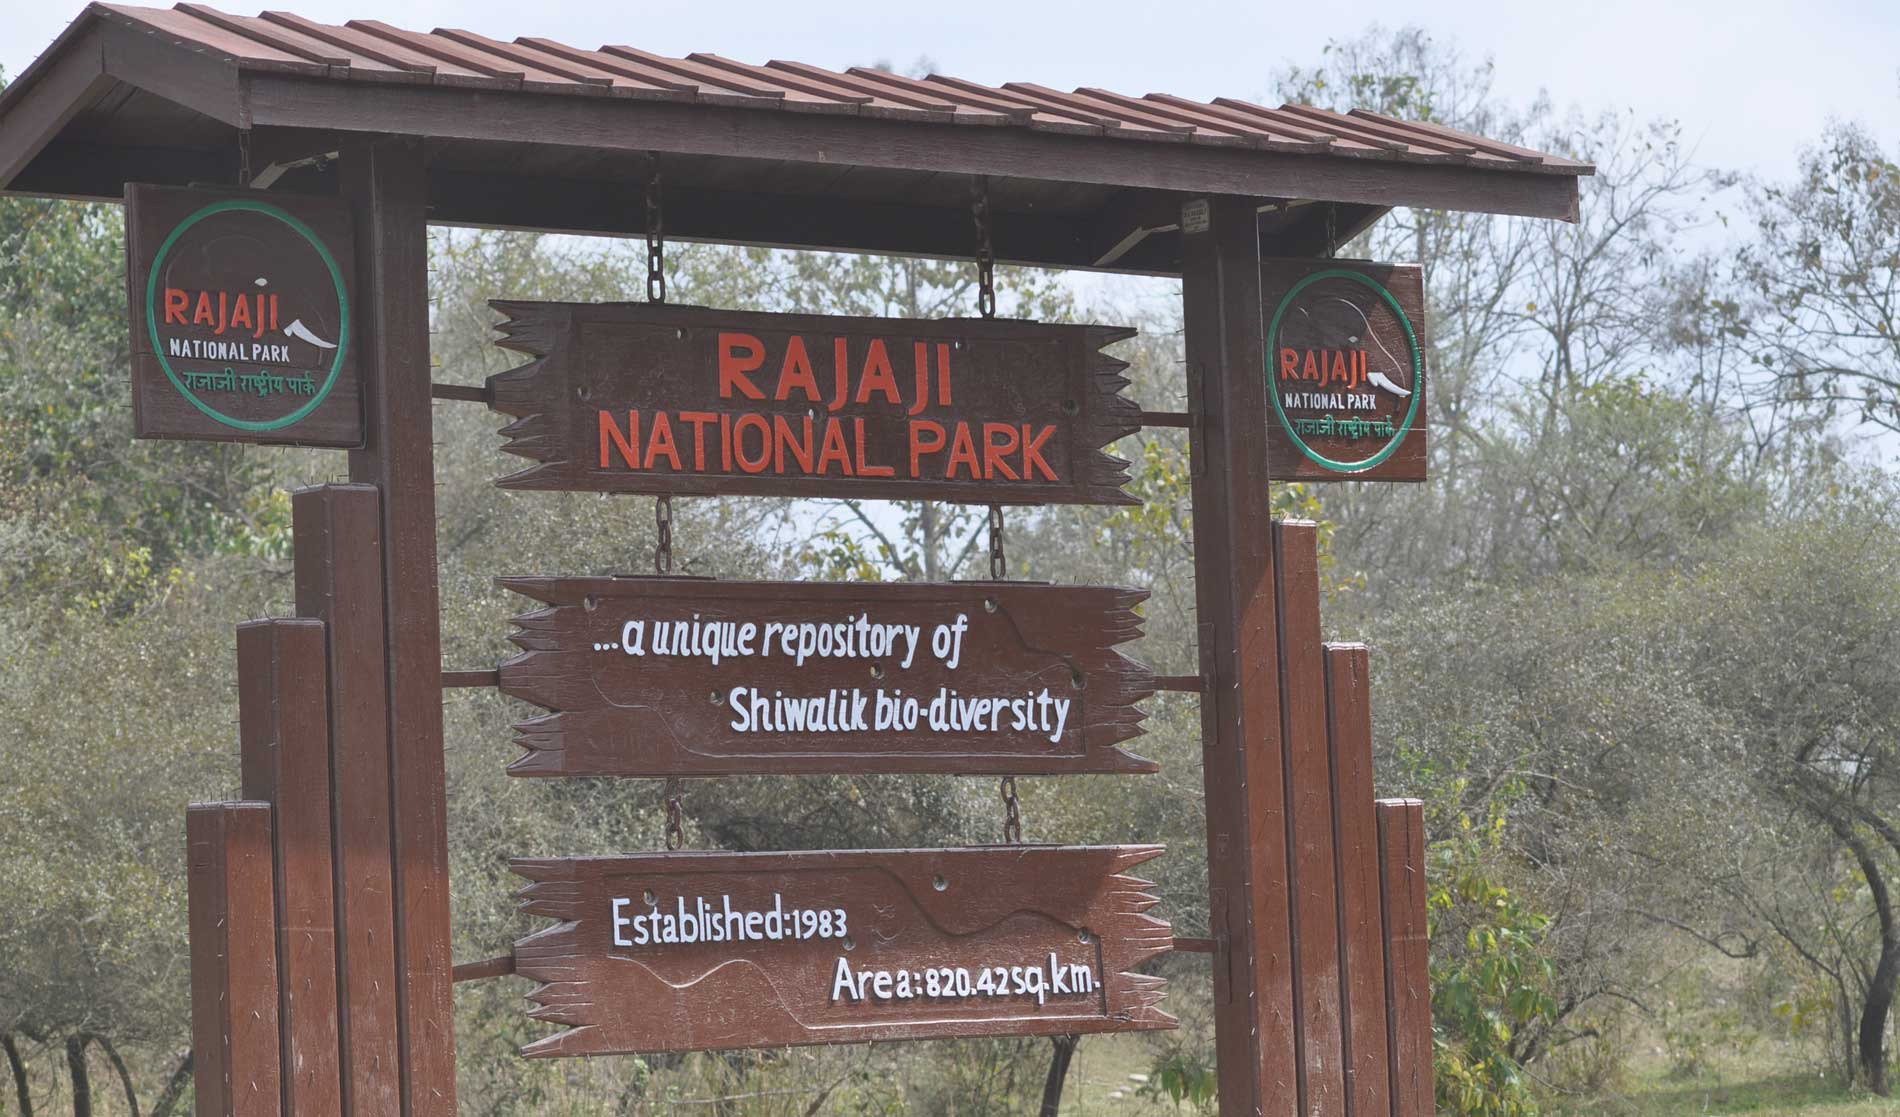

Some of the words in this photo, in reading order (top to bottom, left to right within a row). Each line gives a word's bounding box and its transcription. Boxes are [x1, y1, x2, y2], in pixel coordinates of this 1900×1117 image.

[164, 288, 278, 339] RAJAJI
[169, 338, 249, 361] NATIONAL
[252, 343, 291, 363] PARK
[1280, 349, 1367, 388] RAJAJI
[183, 367, 236, 393] राजाजी
[240, 371, 284, 396] राष्ट्रीय
[286, 371, 315, 395] पार्क
[718, 332, 952, 415] RAJAJI
[1285, 392, 1345, 410] NATIONAL
[1347, 394, 1377, 410] PARK
[598, 409, 895, 478] NATIONAL
[909, 420, 1060, 482] PARK
[1295, 414, 1336, 436] राजाजी
[1337, 416, 1371, 440] राष्ट्रीय
[1374, 415, 1396, 437] पार्क
[650, 612, 755, 667] unique
[761, 612, 920, 668] repository
[932, 613, 968, 669] of
[729, 686, 869, 734] Shiwalik
[876, 687, 1070, 741] bio-diversity
